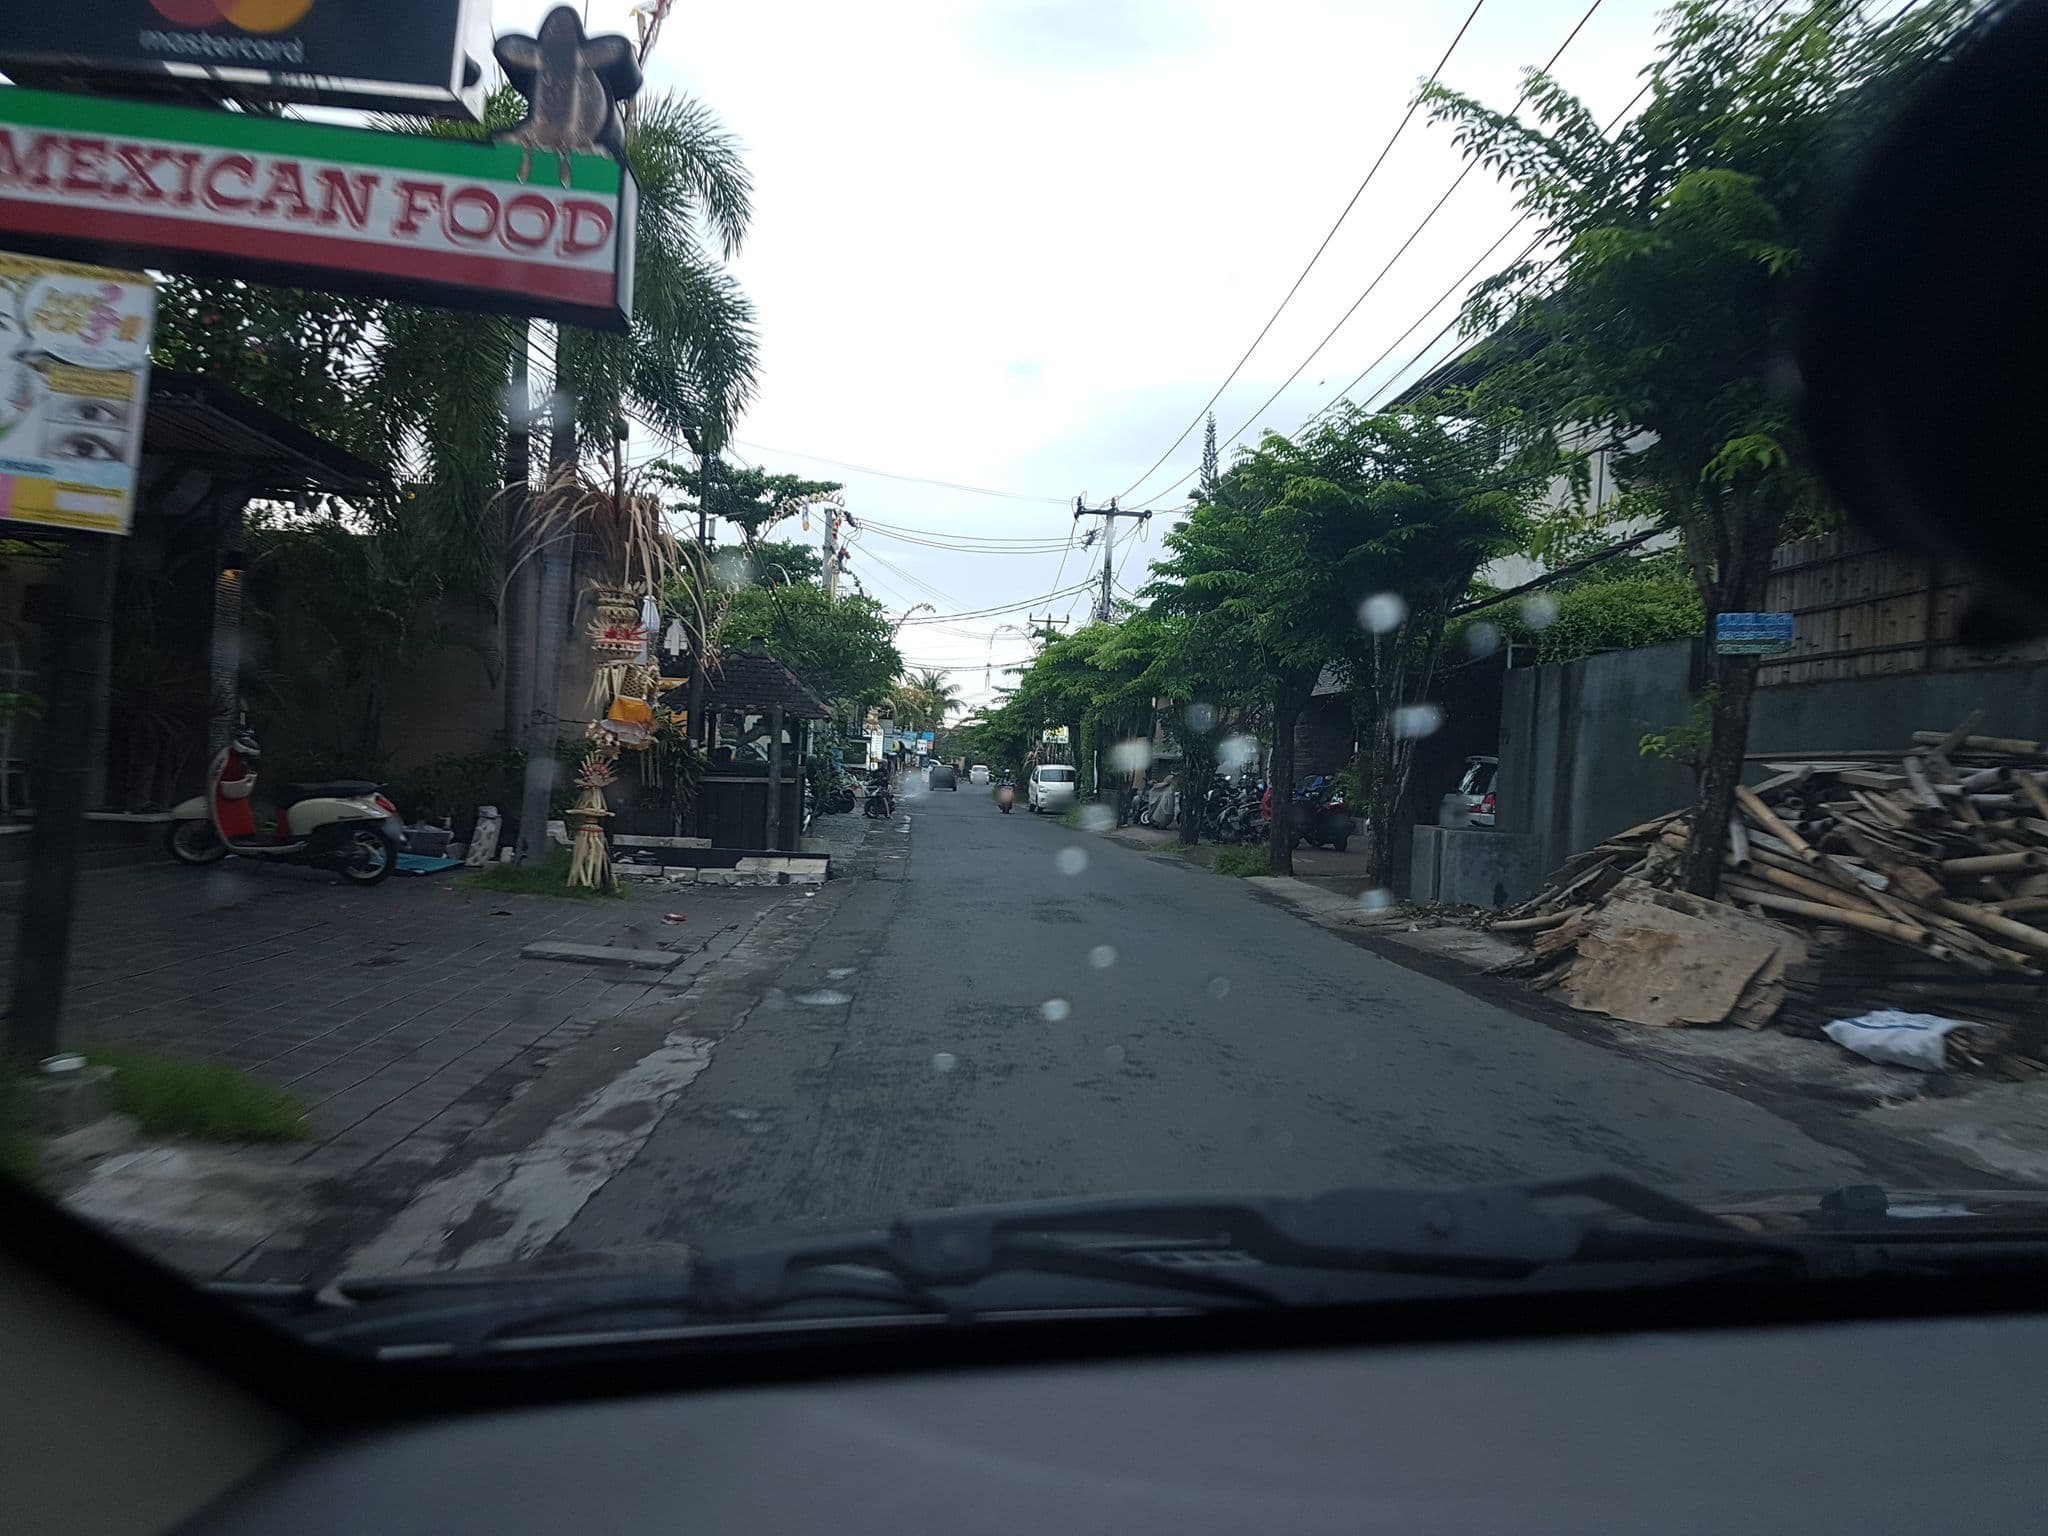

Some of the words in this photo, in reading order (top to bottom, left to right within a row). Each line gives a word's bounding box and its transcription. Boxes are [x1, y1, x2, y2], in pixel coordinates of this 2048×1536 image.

[139, 30, 304, 64] mastercard
[0, 127, 379, 230] MEXICAN
[392, 181, 614, 257] FOOD
